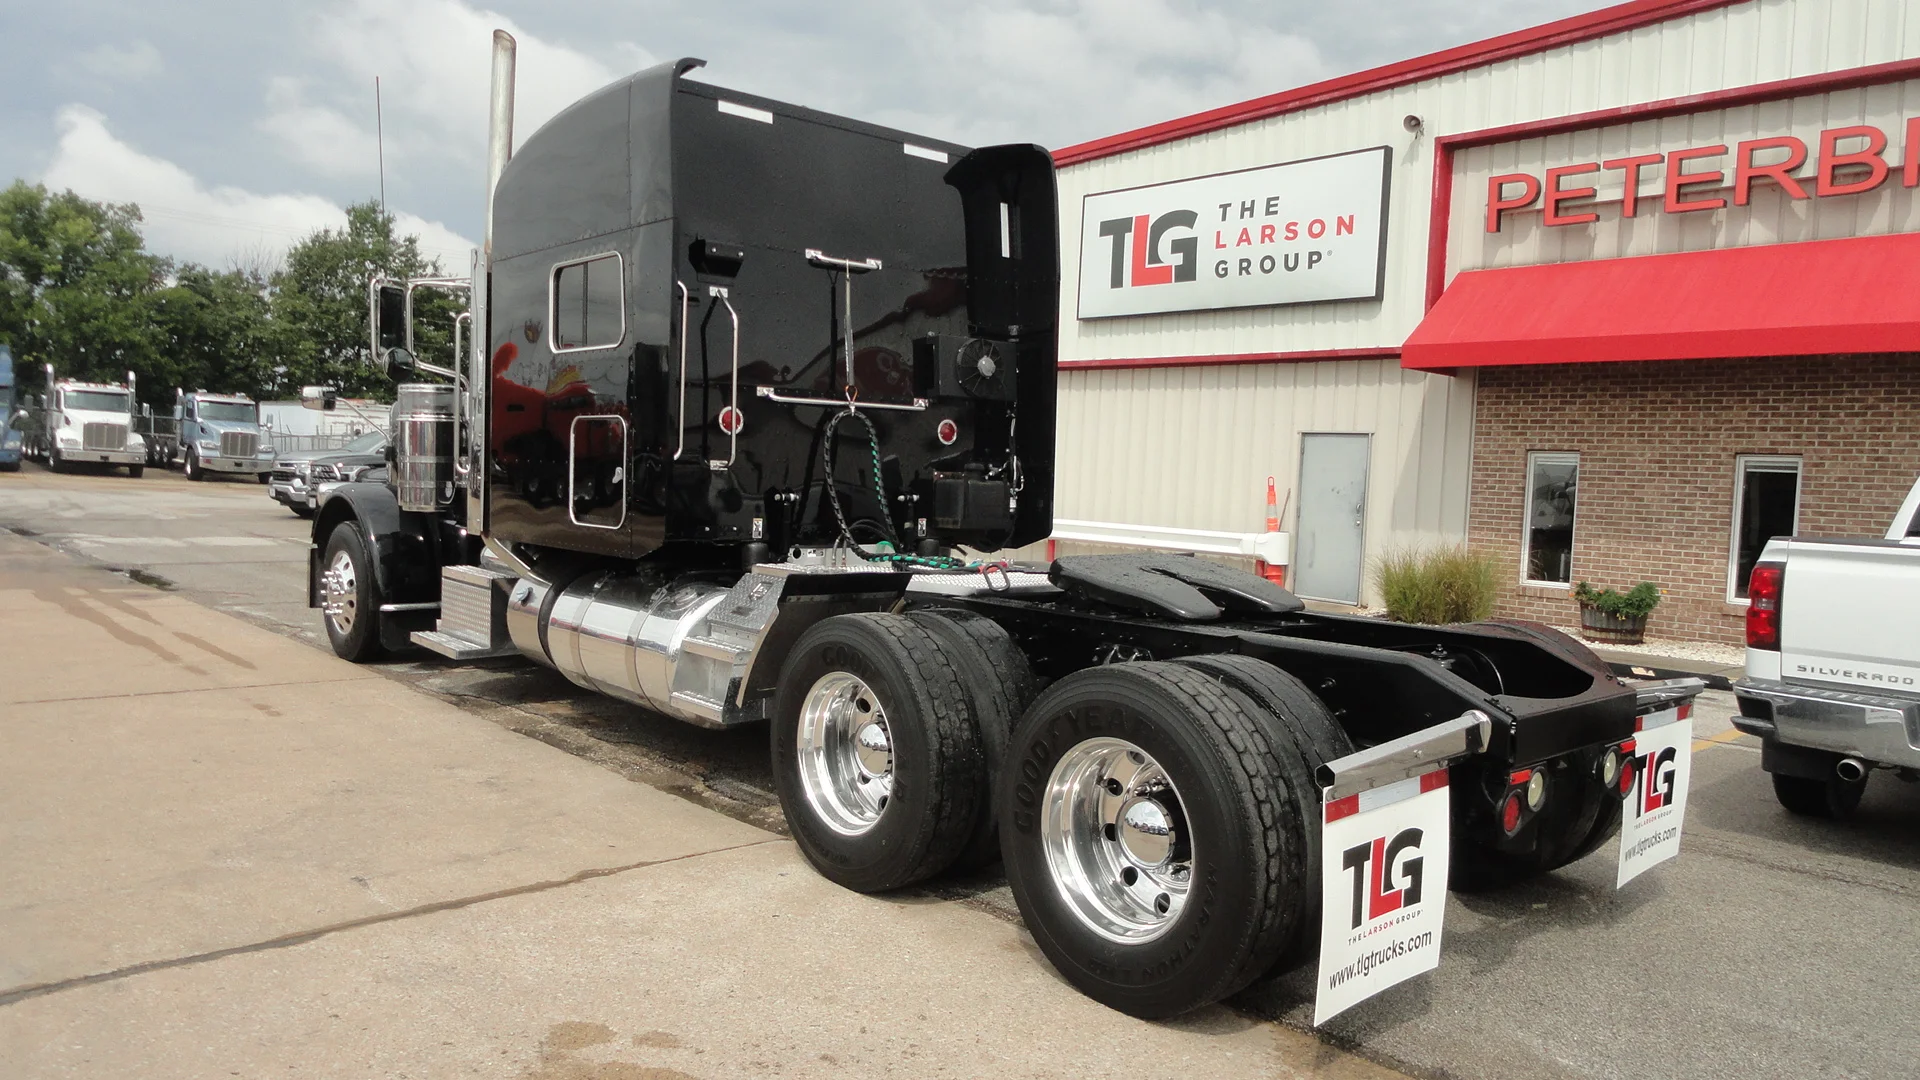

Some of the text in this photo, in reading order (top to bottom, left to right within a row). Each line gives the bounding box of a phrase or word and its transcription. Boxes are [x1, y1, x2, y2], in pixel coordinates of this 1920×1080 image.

[1486, 116, 1920, 234] PETERB
[1215, 214, 1355, 249] LARSON
[1218, 196, 1280, 222] THE
[1099, 209, 1199, 289] TLG
[1797, 665, 1914, 685] SILVERADO
[1635, 746, 1677, 820] TLG
[1342, 827, 1424, 930] TLG
[1348, 911, 1421, 946] THE LARSON GROUP
[1329, 930, 1432, 991] www.tlgtrucks.com
